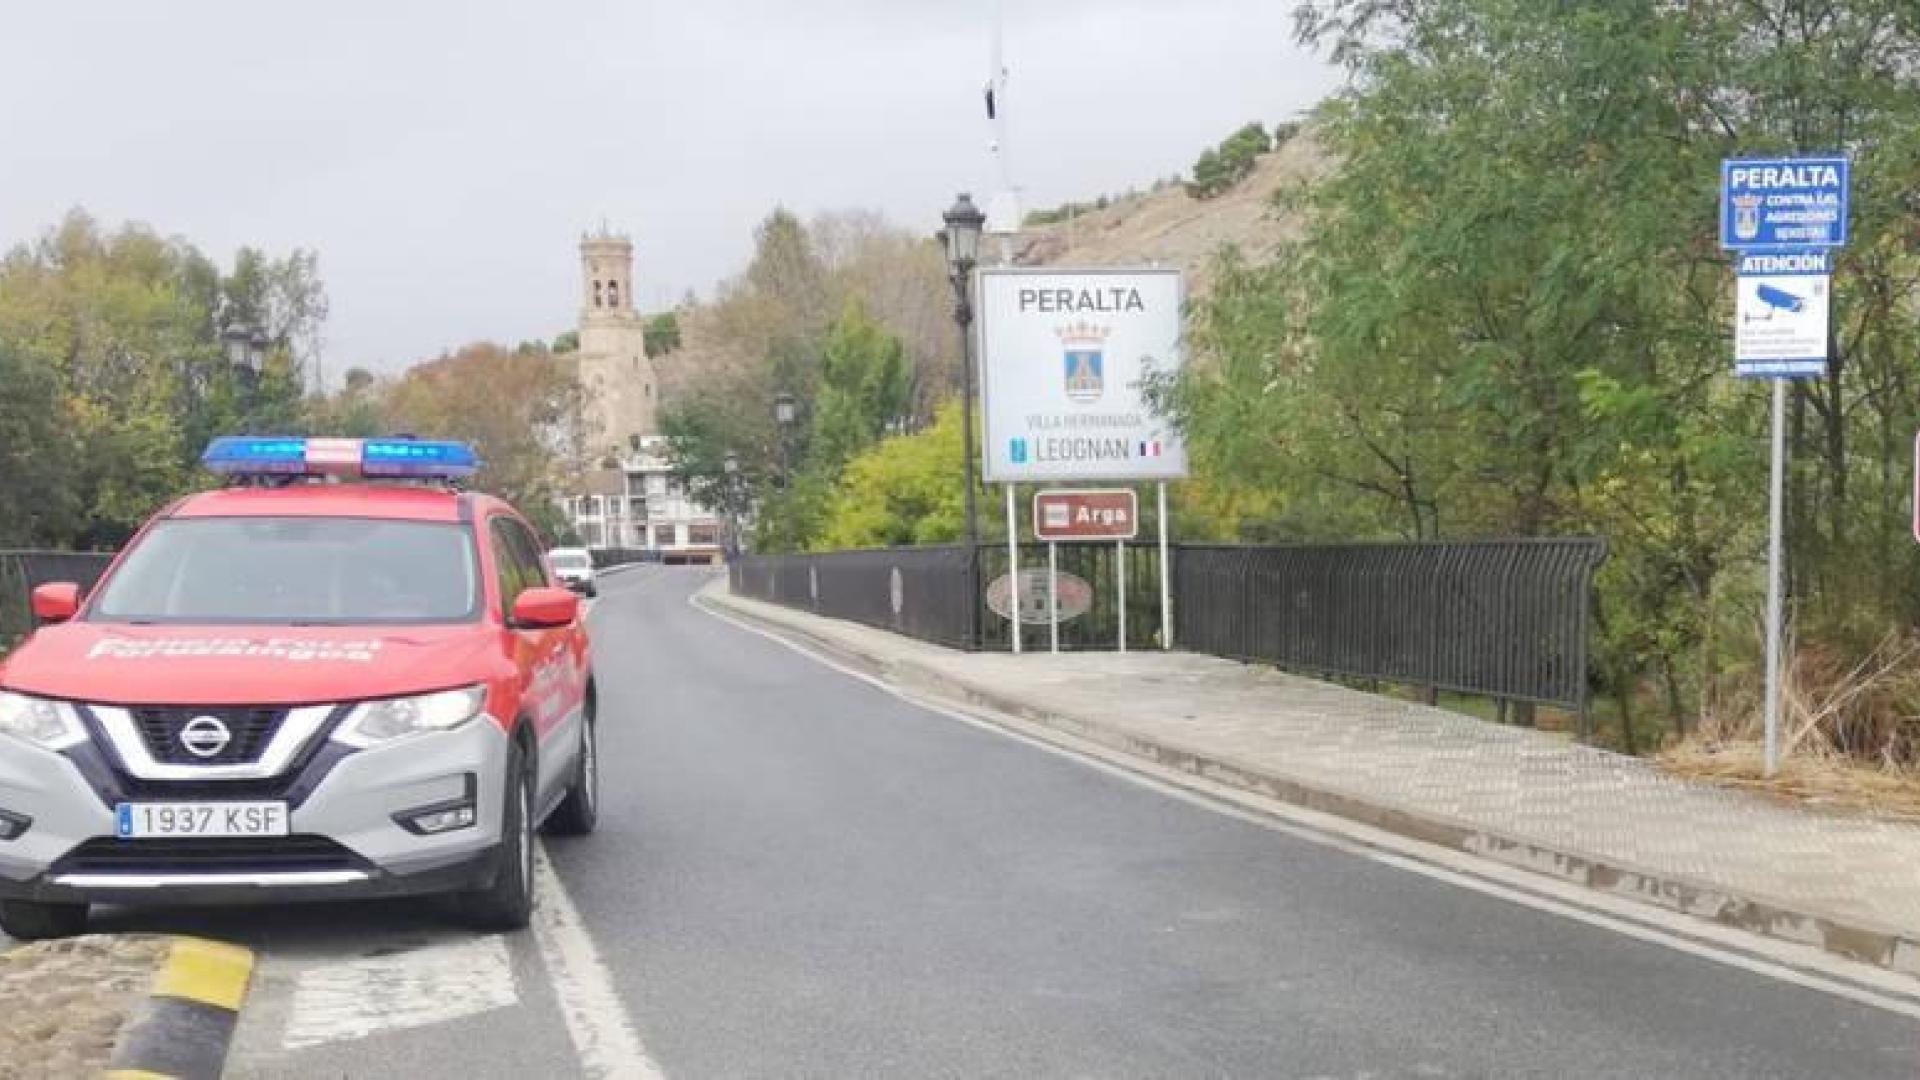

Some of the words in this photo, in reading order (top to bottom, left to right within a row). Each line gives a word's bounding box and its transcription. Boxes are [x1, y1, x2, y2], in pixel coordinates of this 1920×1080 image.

[1732, 166, 1839, 189] PERALTA
[1742, 253, 1825, 271] ATENCIÓN
[1019, 287, 1144, 313] PERALTA
[1024, 414, 1061, 429] VILLA
[1036, 438, 1129, 461] LEOGNAN
[1076, 505, 1127, 527] Arga
[144, 807, 214, 833] 1937
[225, 807, 281, 833] KSF
